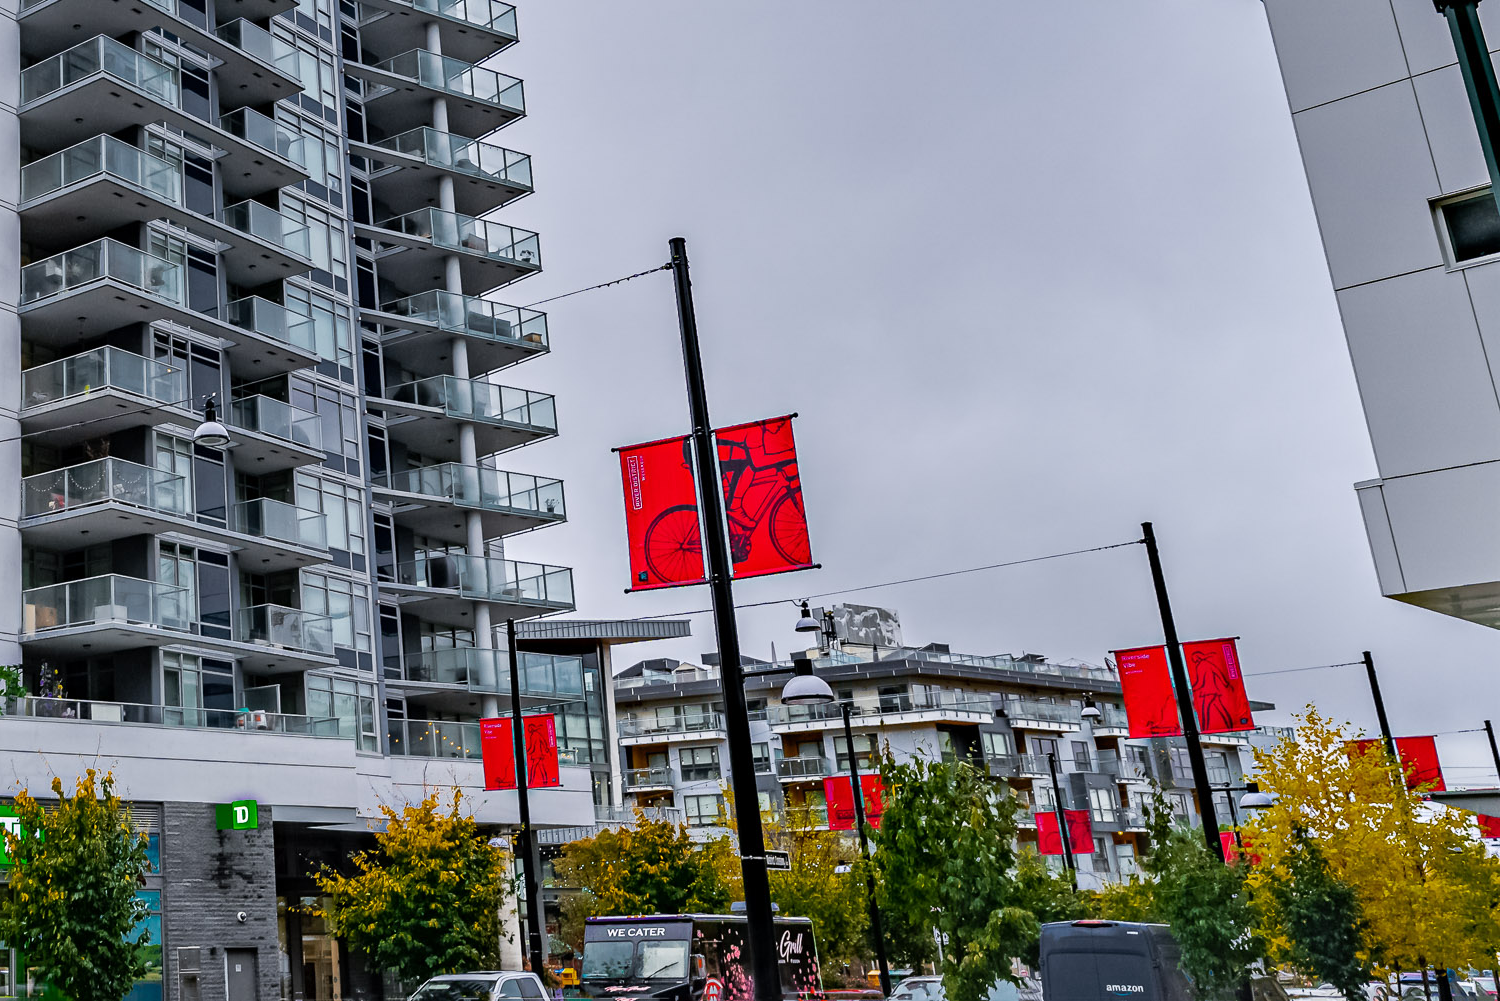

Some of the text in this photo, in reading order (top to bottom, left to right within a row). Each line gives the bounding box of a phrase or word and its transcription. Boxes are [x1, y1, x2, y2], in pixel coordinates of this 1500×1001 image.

[234, 806, 249, 824] TD
[607, 927, 666, 937] WE CATER
[1106, 984, 1144, 993] amazon
